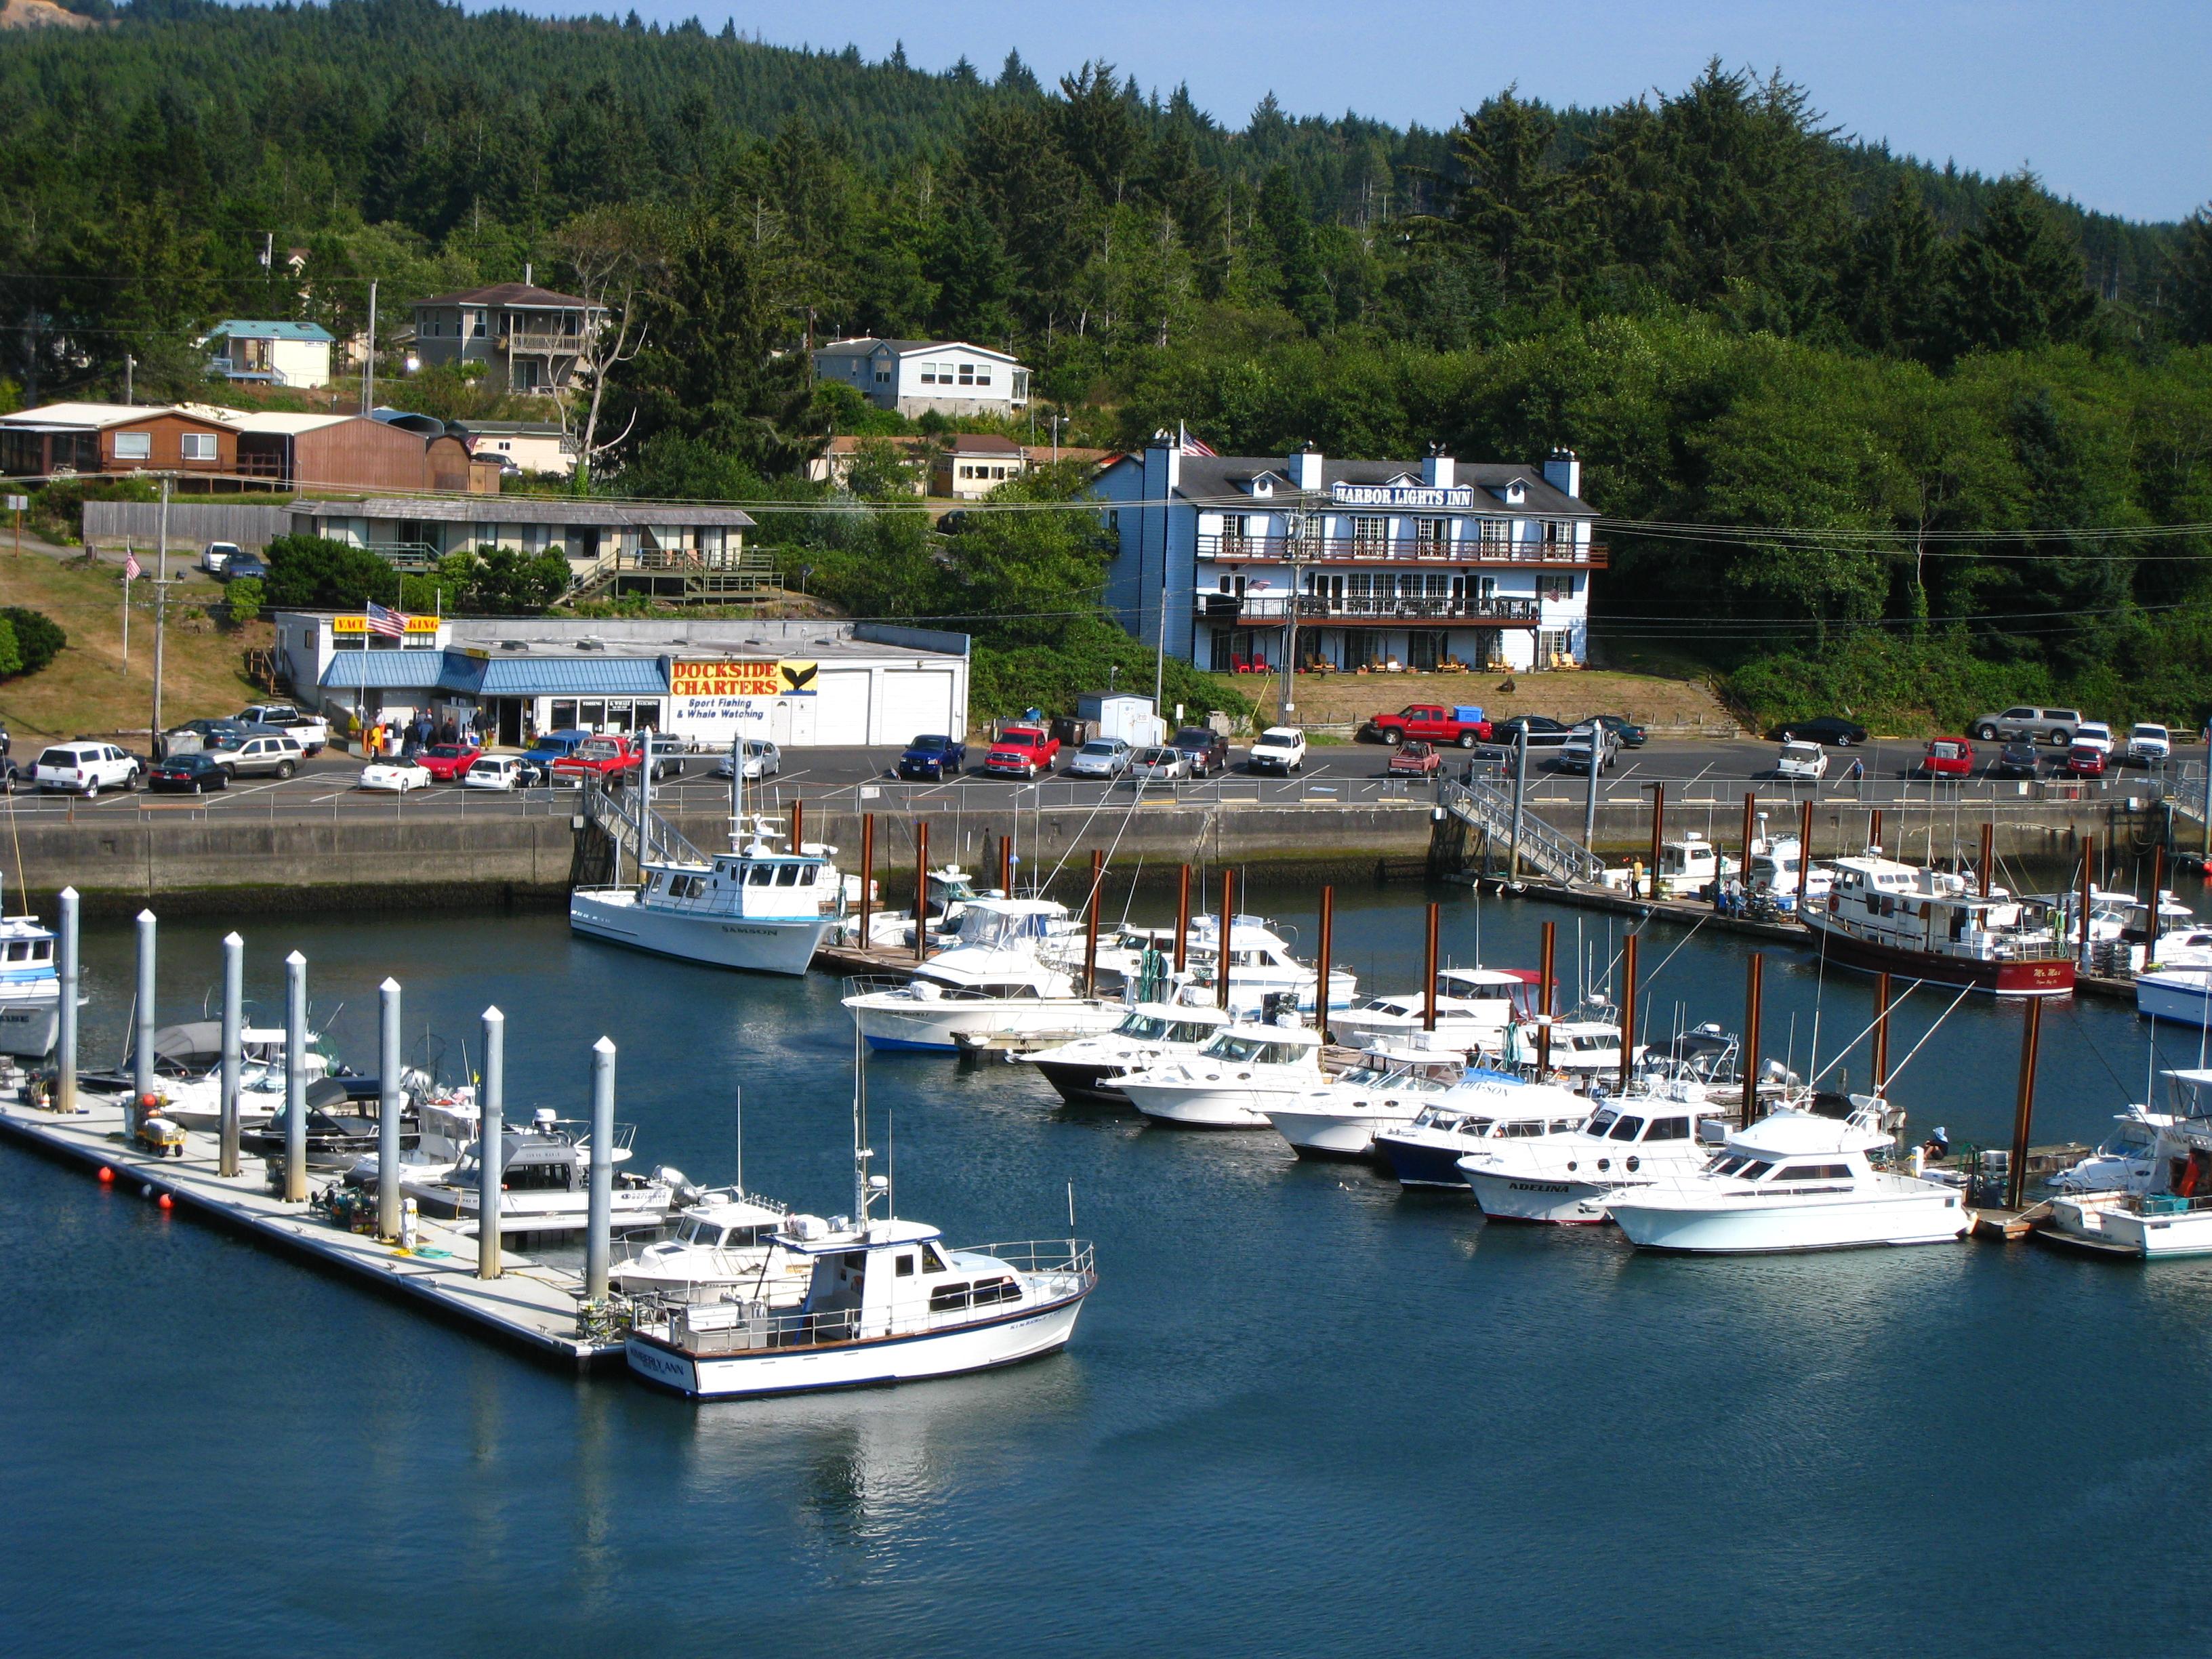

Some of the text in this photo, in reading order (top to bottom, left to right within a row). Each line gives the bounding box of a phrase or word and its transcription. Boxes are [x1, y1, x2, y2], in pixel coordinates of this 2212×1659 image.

[1336, 488, 1471, 506] HARBOR LIGHTS INN
[338, 619, 438, 629] VACU KING
[672, 662, 777, 678] DOCKSIDE
[672, 680, 778, 695] CHARTERS
[689, 699, 752, 710] Sport Fishing
[676, 710, 764, 720] & Whale Watching
[722, 925, 778, 937] SAMSON
[1509, 1182, 1570, 1193] ADELINA
[664, 1361, 684, 1376] ANN
